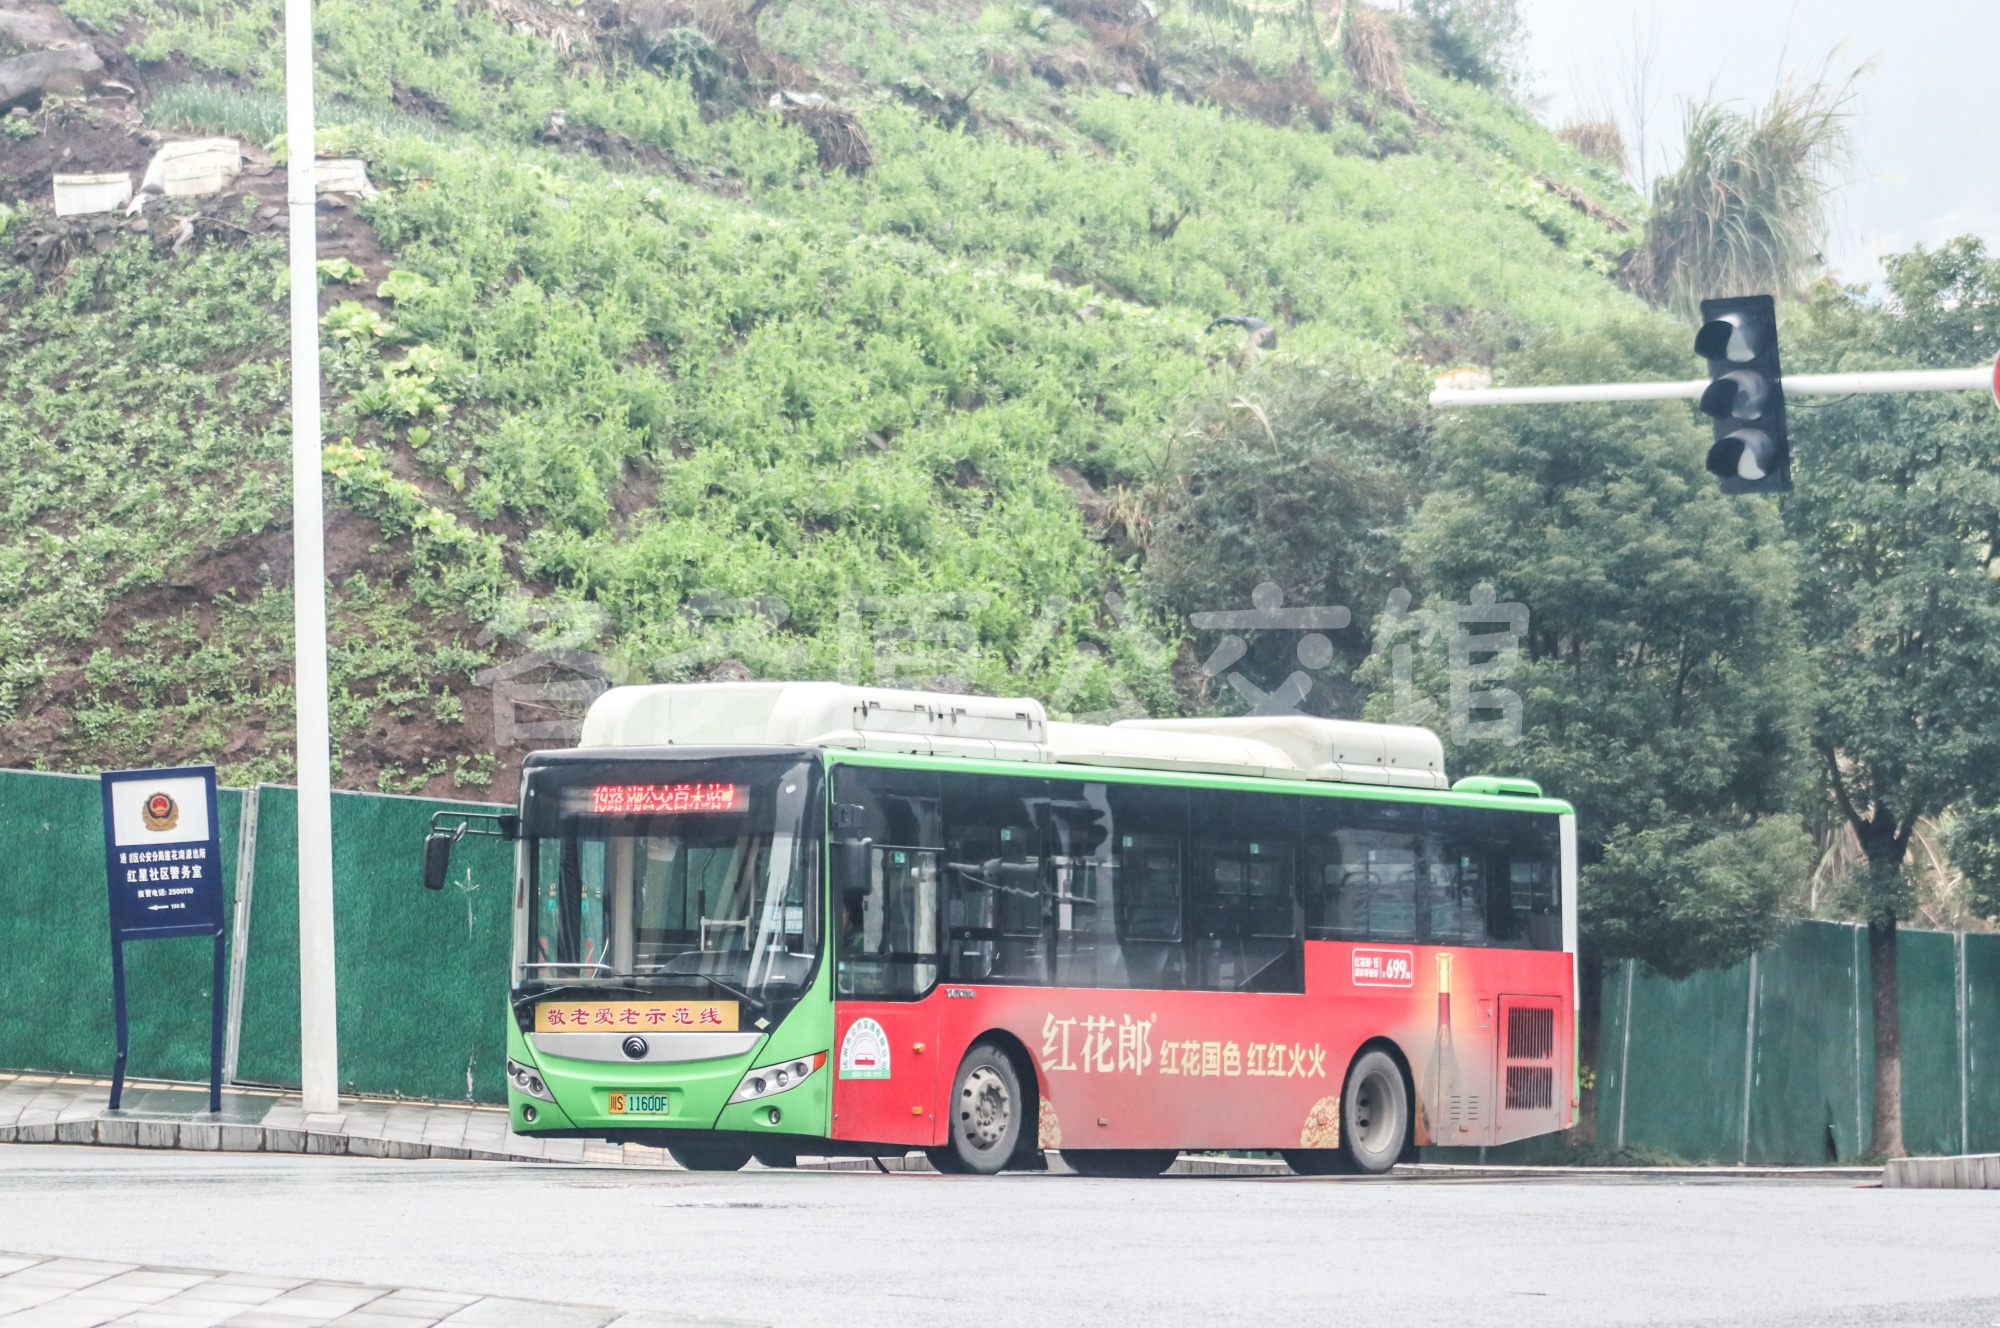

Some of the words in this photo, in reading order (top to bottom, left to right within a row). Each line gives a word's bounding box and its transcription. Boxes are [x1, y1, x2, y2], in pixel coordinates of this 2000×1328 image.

[127, 865, 202, 882] 红星社区警务室
[546, 1006, 723, 1026] 敬老爱老示范线
[1041, 1012, 1152, 1076] 红花郎
[1159, 1040, 1242, 1077] 红花国色
[1246, 1041, 1327, 1078] 红红火火
